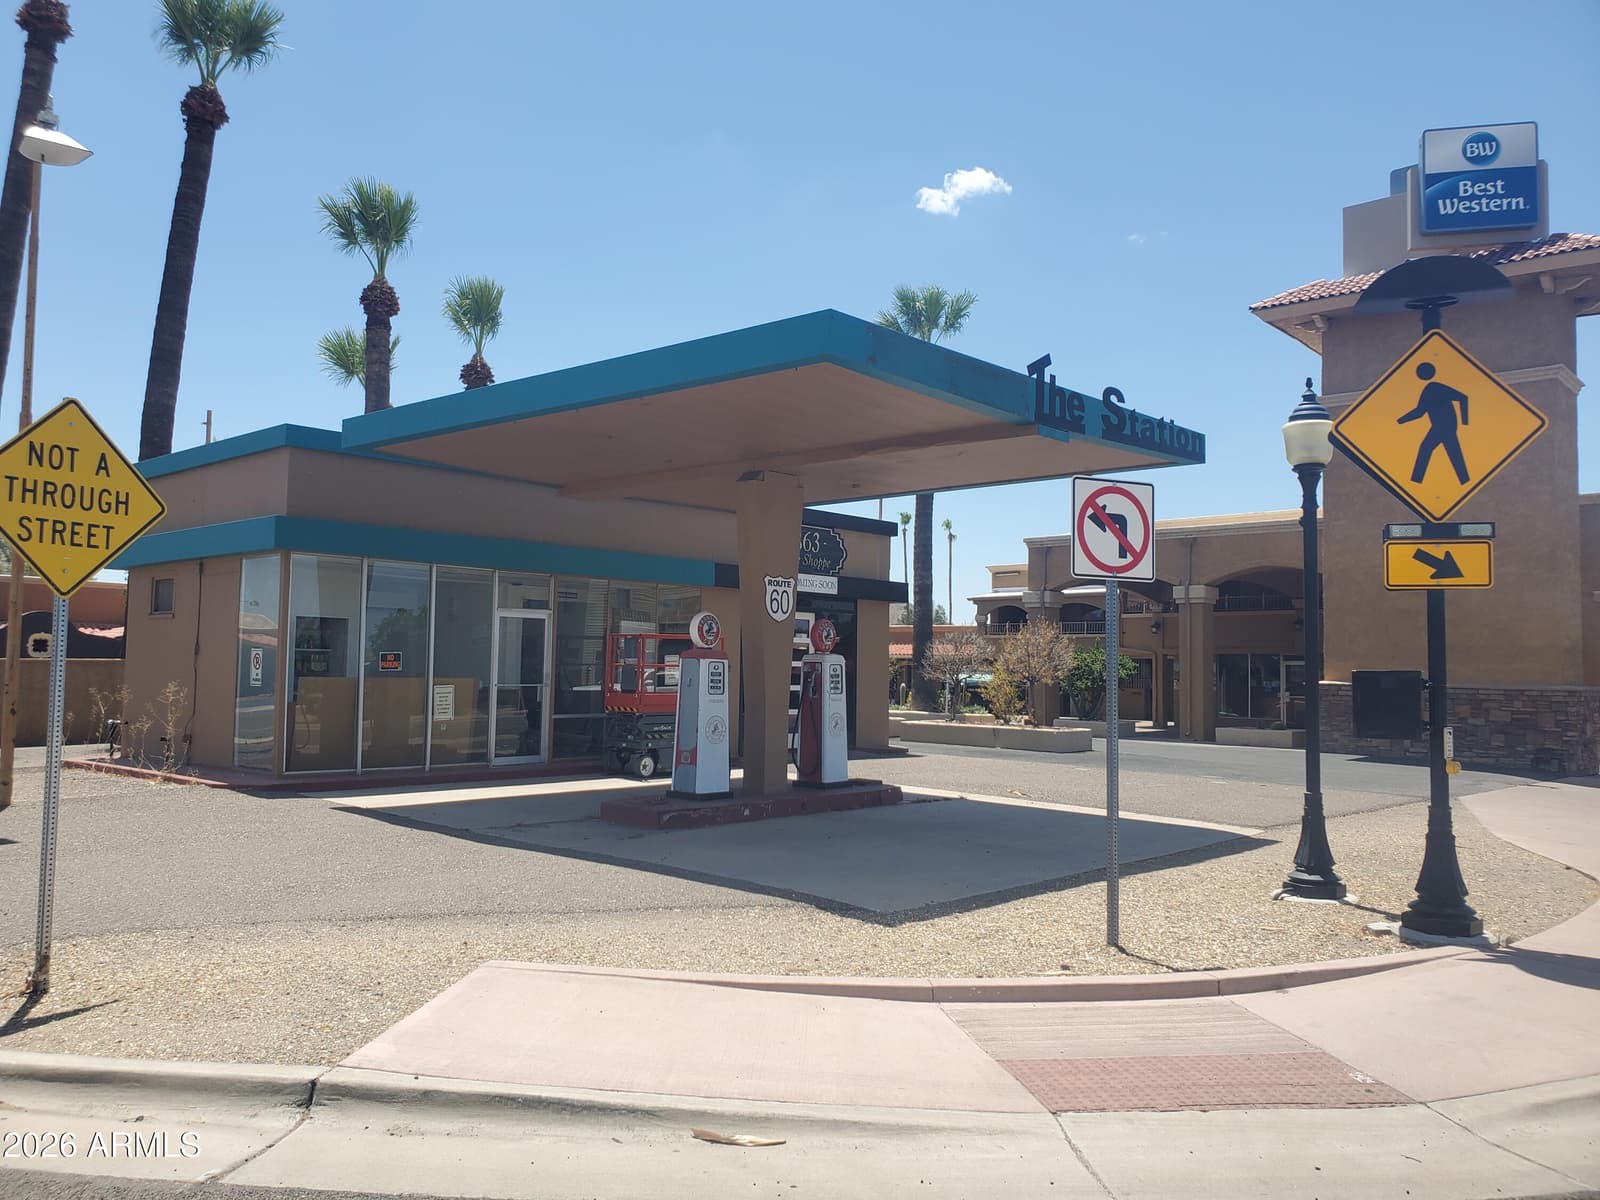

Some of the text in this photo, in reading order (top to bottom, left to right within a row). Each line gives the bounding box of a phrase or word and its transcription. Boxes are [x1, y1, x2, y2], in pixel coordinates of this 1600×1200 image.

[1466, 141, 1497, 158] BW
[1458, 180, 1505, 197] Best
[1438, 197, 1525, 216] Western
[1027, 353, 1206, 460] The Station
[28, 440, 110, 478] NOT A
[4, 475, 129, 516] THROUGH
[17, 515, 114, 550] STREET
[767, 579, 792, 588] ROUTE
[770, 589, 789, 615] 60
